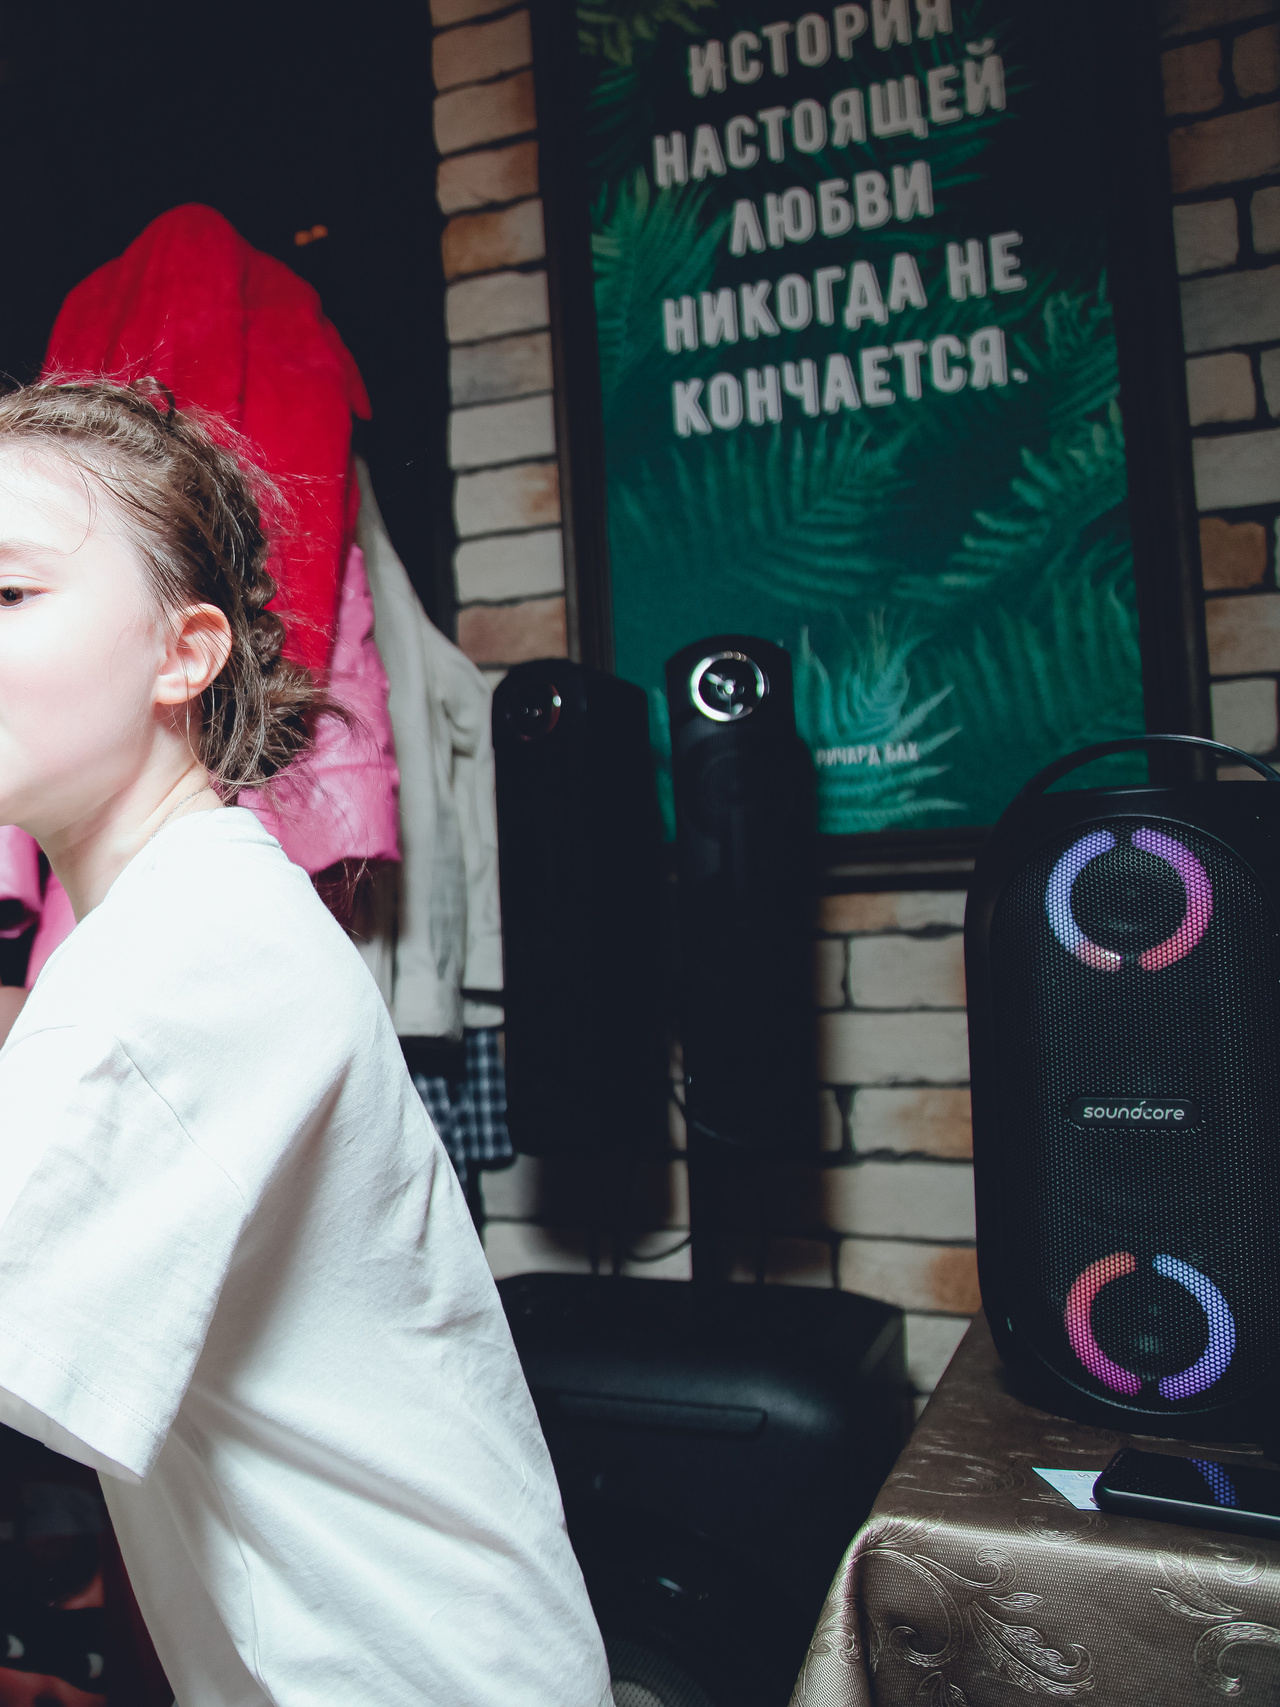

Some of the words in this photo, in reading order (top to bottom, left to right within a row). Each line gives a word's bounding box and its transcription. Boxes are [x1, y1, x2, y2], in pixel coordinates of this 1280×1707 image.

[688, 0, 954, 97] ИСТОРИЯ
[652, 38, 1008, 190] НАСТОЯЩЕЙ
[729, 160, 935, 257] ЛЮБВИ
[662, 252, 928, 354] НИКОГДА
[946, 230, 1028, 301] НЕ
[671, 326, 1029, 438] КОНЧАЕТСЯ.
[816, 743, 881, 766] РИЧАРД
[1082, 1100, 1186, 1121] soundcore
